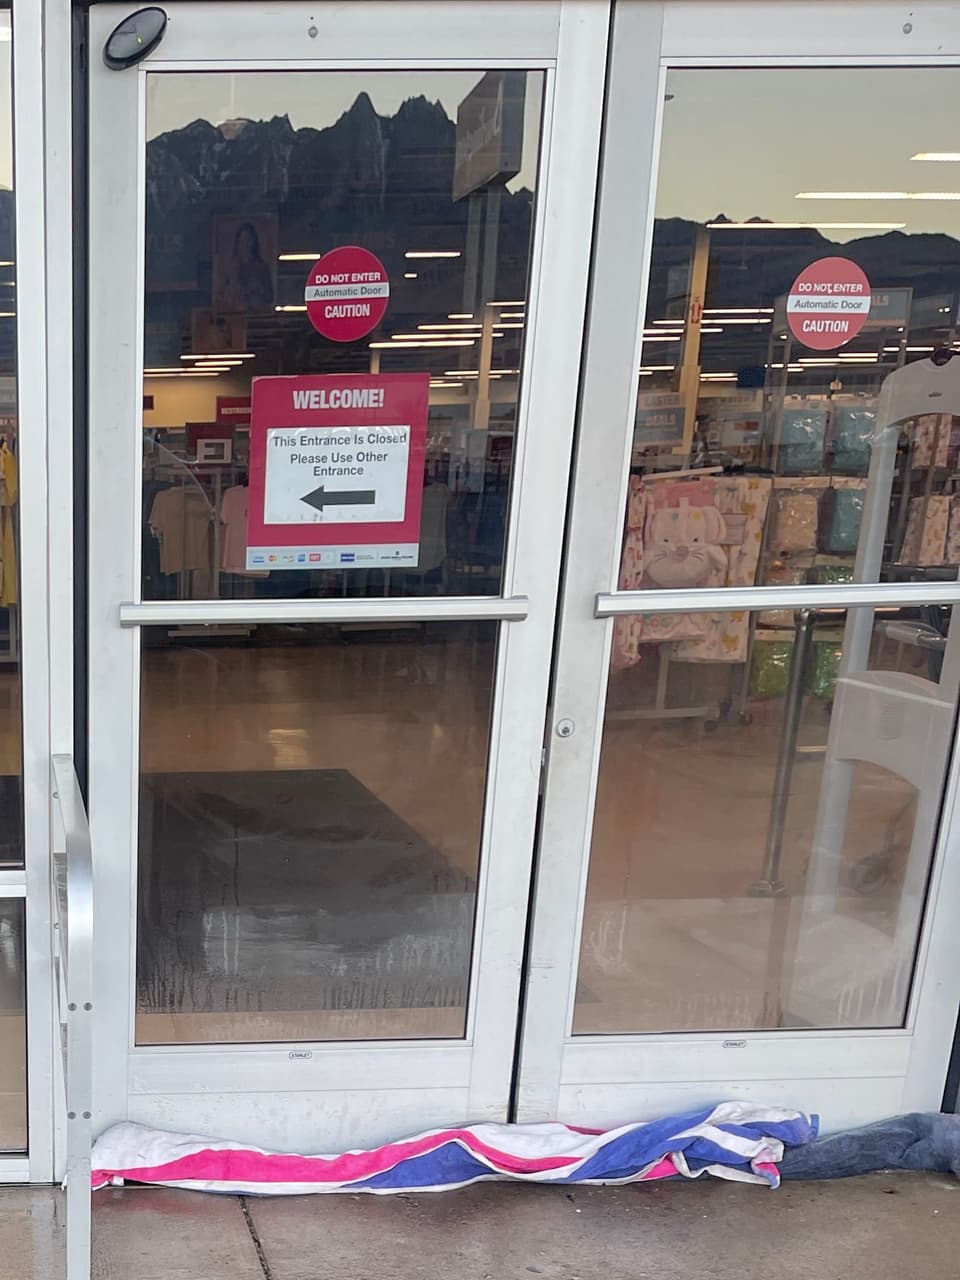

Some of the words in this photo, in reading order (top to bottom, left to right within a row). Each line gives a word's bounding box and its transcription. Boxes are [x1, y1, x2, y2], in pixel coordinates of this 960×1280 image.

[315, 275, 329, 284] DO
[331, 273, 350, 283] NOT
[351, 272, 381, 282] ENTER
[313, 288, 358, 297] Automatic
[360, 286, 382, 295] Door
[798, 283, 812, 292] DO
[813, 283, 832, 292] NOT
[833, 283, 863, 292] ENTER
[794, 300, 839, 309] Automatic
[841, 300, 863, 309] Door
[325, 304, 370, 318] CAUTION
[802, 320, 849, 332] CAUTION
[292, 389, 385, 410] WELCOME!
[273, 436, 297, 447] This
[300, 435, 351, 446] Entrance
[354, 434, 364, 444] Is
[367, 433, 407, 444] Closed
[290, 453, 328, 464] Please
[331, 453, 353, 463] Use
[356, 451, 388, 462] Other
[313, 465, 364, 476] Entrance
